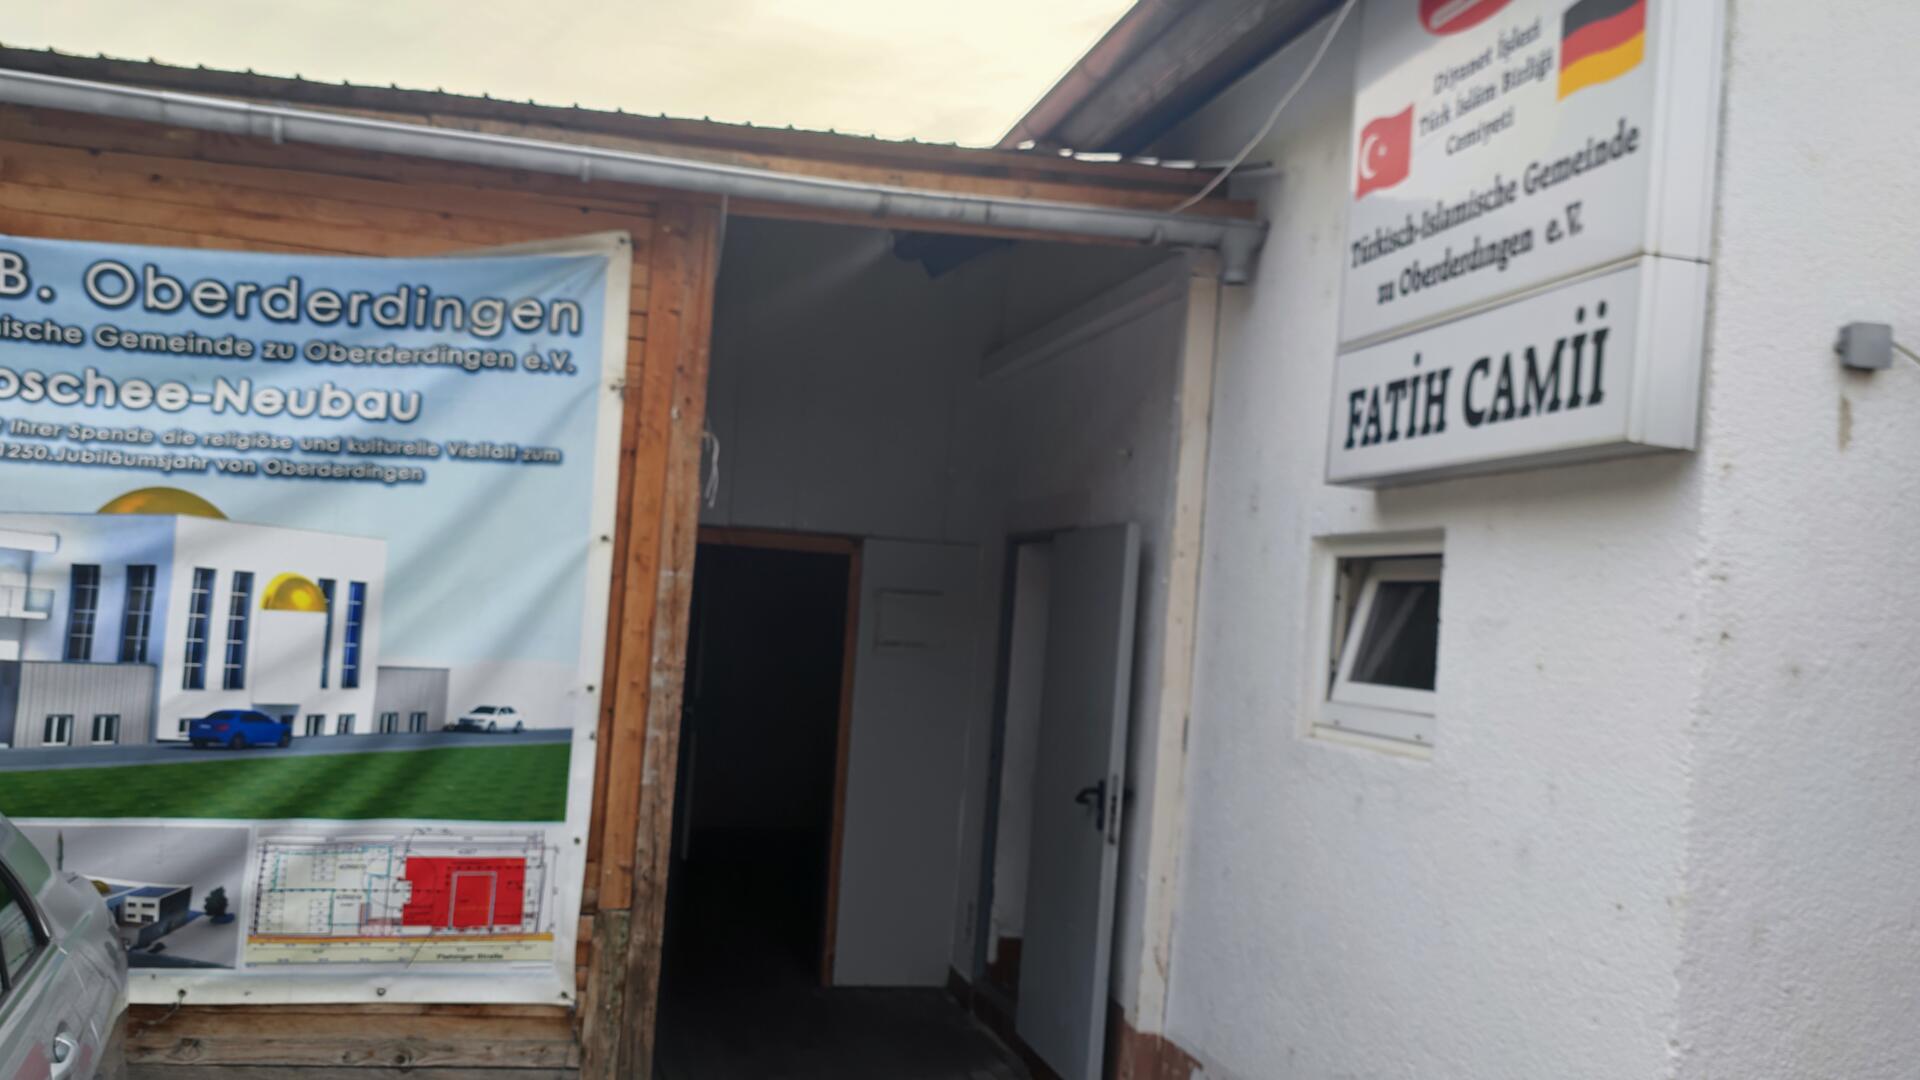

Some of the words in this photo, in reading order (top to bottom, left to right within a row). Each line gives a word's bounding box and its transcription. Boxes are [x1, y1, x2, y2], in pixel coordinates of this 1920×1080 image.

[1420, 104, 1450, 137] Türk
[1446, 106, 1515, 155] Cemiyeti
[1351, 173, 1518, 268] Türkisch-Islamische
[1523, 118, 1640, 196] Gemeinde
[1399, 228, 1534, 297] Oberderdingen
[85, 260, 582, 337] Oberderdingen
[0, 315, 83, 345] ische
[94, 325, 254, 358] Gemeinde
[262, 342, 295, 361] zu
[303, 338, 515, 371] Oberderdingen
[523, 351, 577, 374] e.V.
[1344, 351, 1452, 450] FATİH
[10, 418, 62, 438] Ihrer
[68, 423, 154, 444] Spende
[160, 430, 196, 446] die
[202, 430, 293, 451] religiöse
[300, 437, 341, 452] und
[347, 438, 440, 458] kulturelle
[447, 442, 517, 462] Vielfalt
[521, 449, 562, 464] zum
[214, 460, 256, 474] von
[262, 457, 424, 484] Oberderdingen
